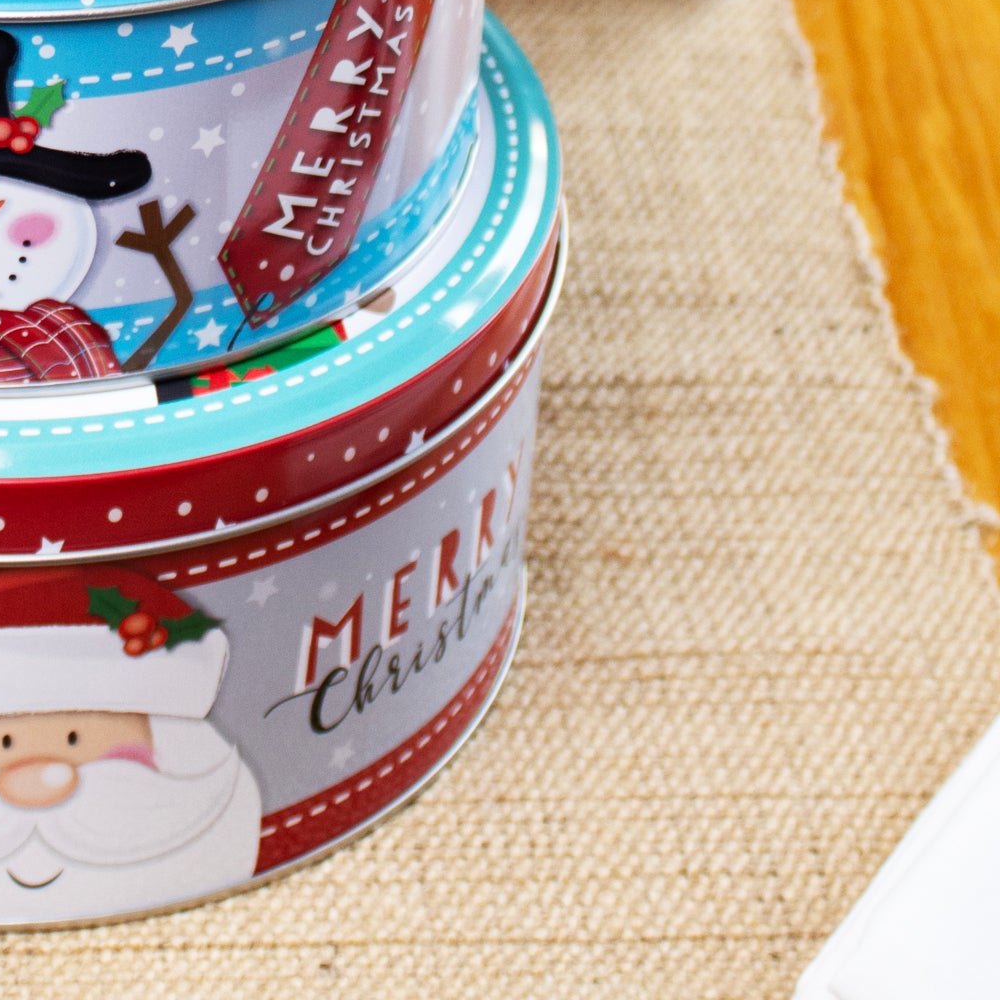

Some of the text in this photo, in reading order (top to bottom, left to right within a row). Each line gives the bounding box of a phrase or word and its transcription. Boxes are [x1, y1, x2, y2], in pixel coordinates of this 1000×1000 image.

[261, 5, 384, 240] MERRY
[306, 5, 414, 256] CHRISTMAS
[264, 522, 520, 734] Christm
[293, 440, 524, 695] MERRY
